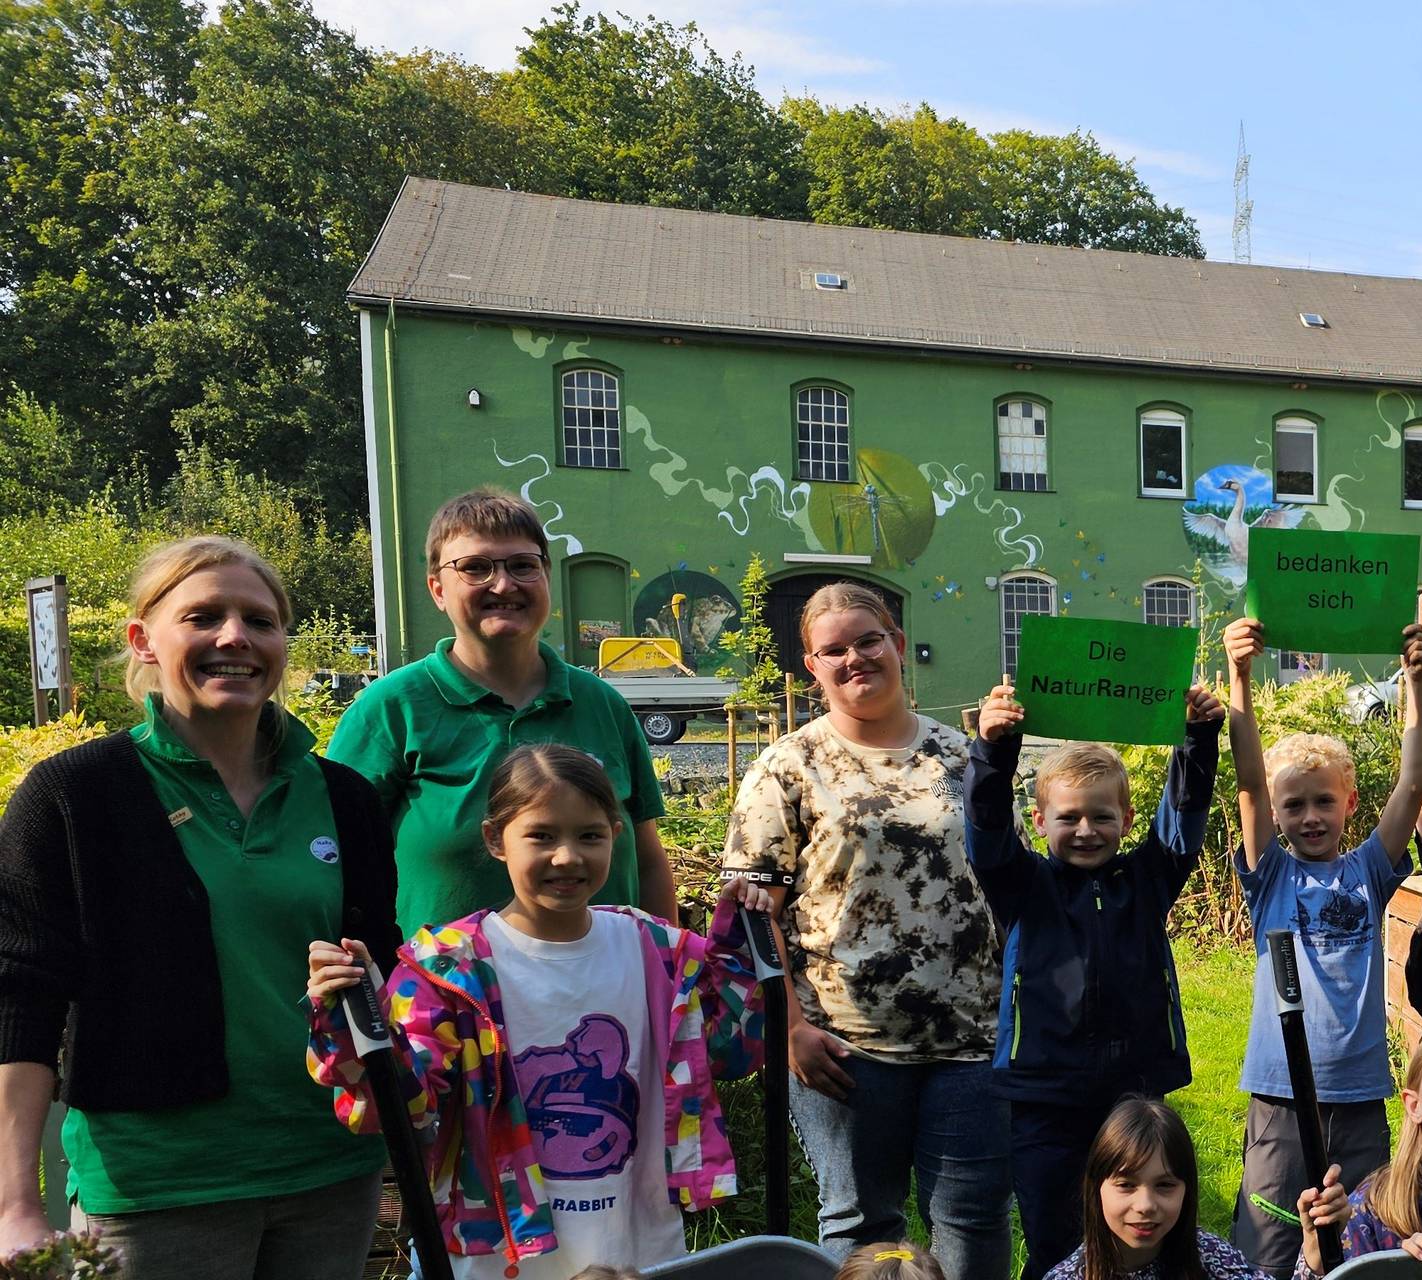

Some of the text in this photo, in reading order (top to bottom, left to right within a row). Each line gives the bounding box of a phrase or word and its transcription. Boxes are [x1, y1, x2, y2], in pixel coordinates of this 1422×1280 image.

[1276, 551, 1389, 575] bedanken
[1307, 588, 1355, 610] sich
[1088, 640, 1127, 662] Die
[1030, 675, 1176, 706] NaturRanger
[552, 1197, 617, 1213] RABBIT
